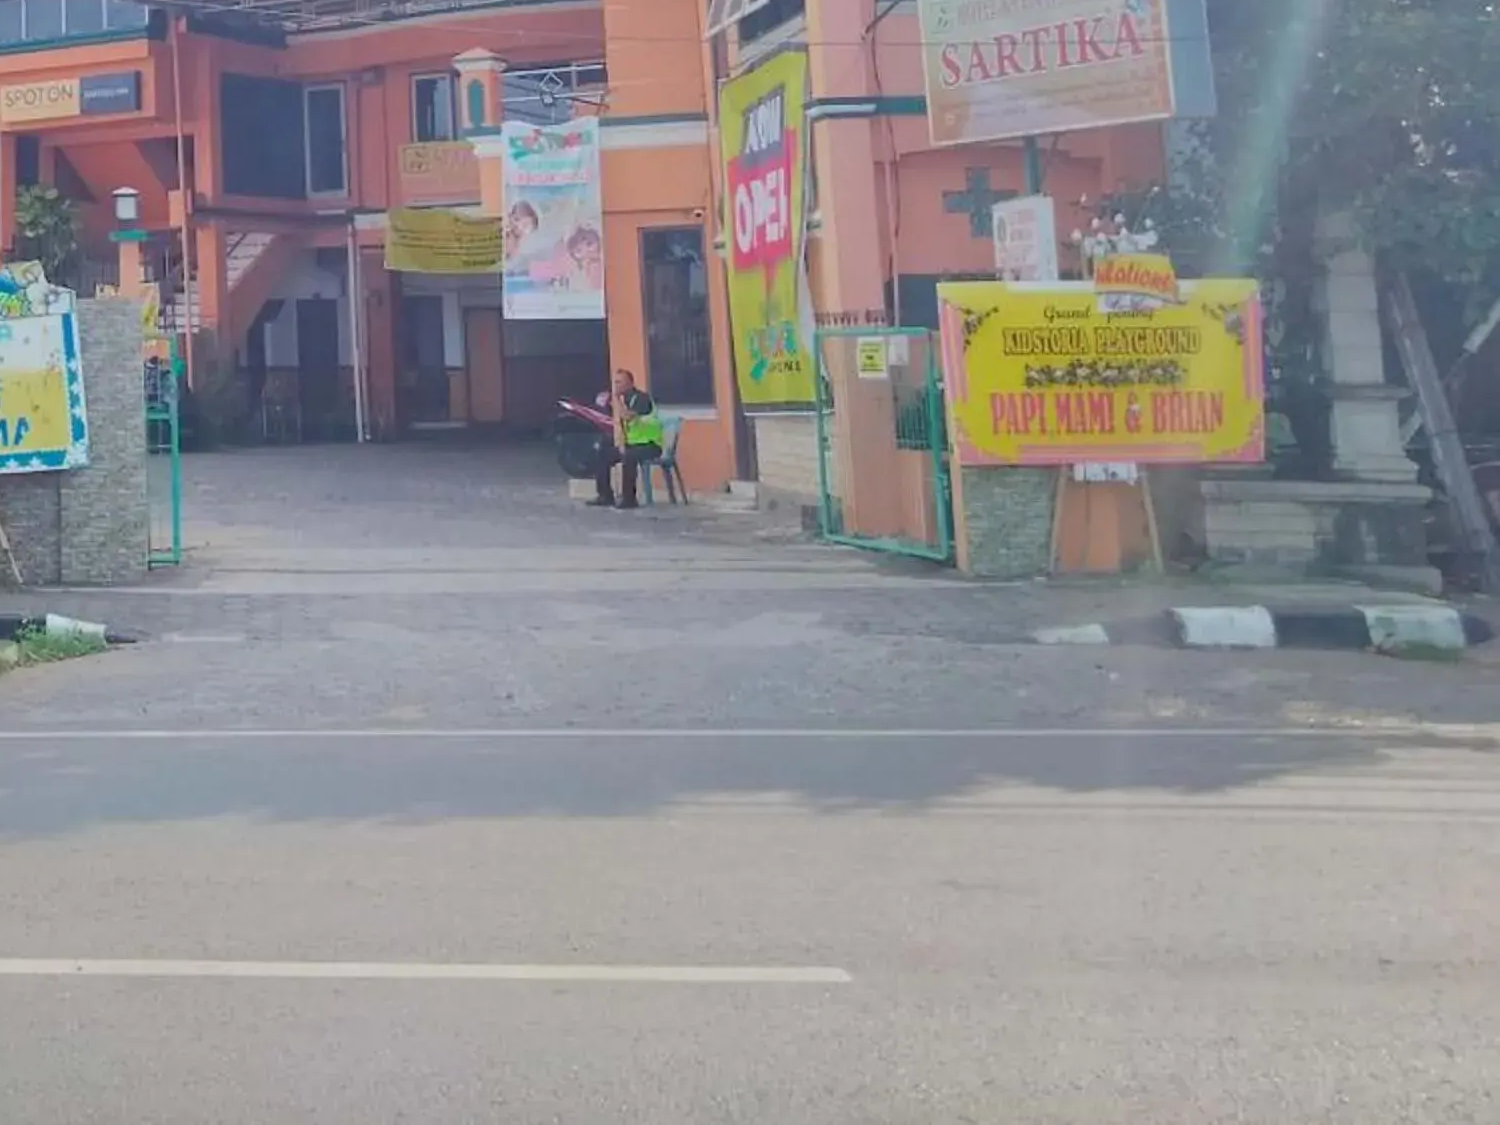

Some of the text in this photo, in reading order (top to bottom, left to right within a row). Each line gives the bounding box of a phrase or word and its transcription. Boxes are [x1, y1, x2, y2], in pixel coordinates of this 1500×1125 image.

[940, 12, 1144, 87] SARTIKA
[5, 87, 44, 107] SPOT
[47, 84, 74, 103] ON
[1002, 326, 1201, 355] KIDSTORIA PLAYGROUND
[1055, 392, 1115, 435] MAMI
[1152, 390, 1224, 433] BRIAN
